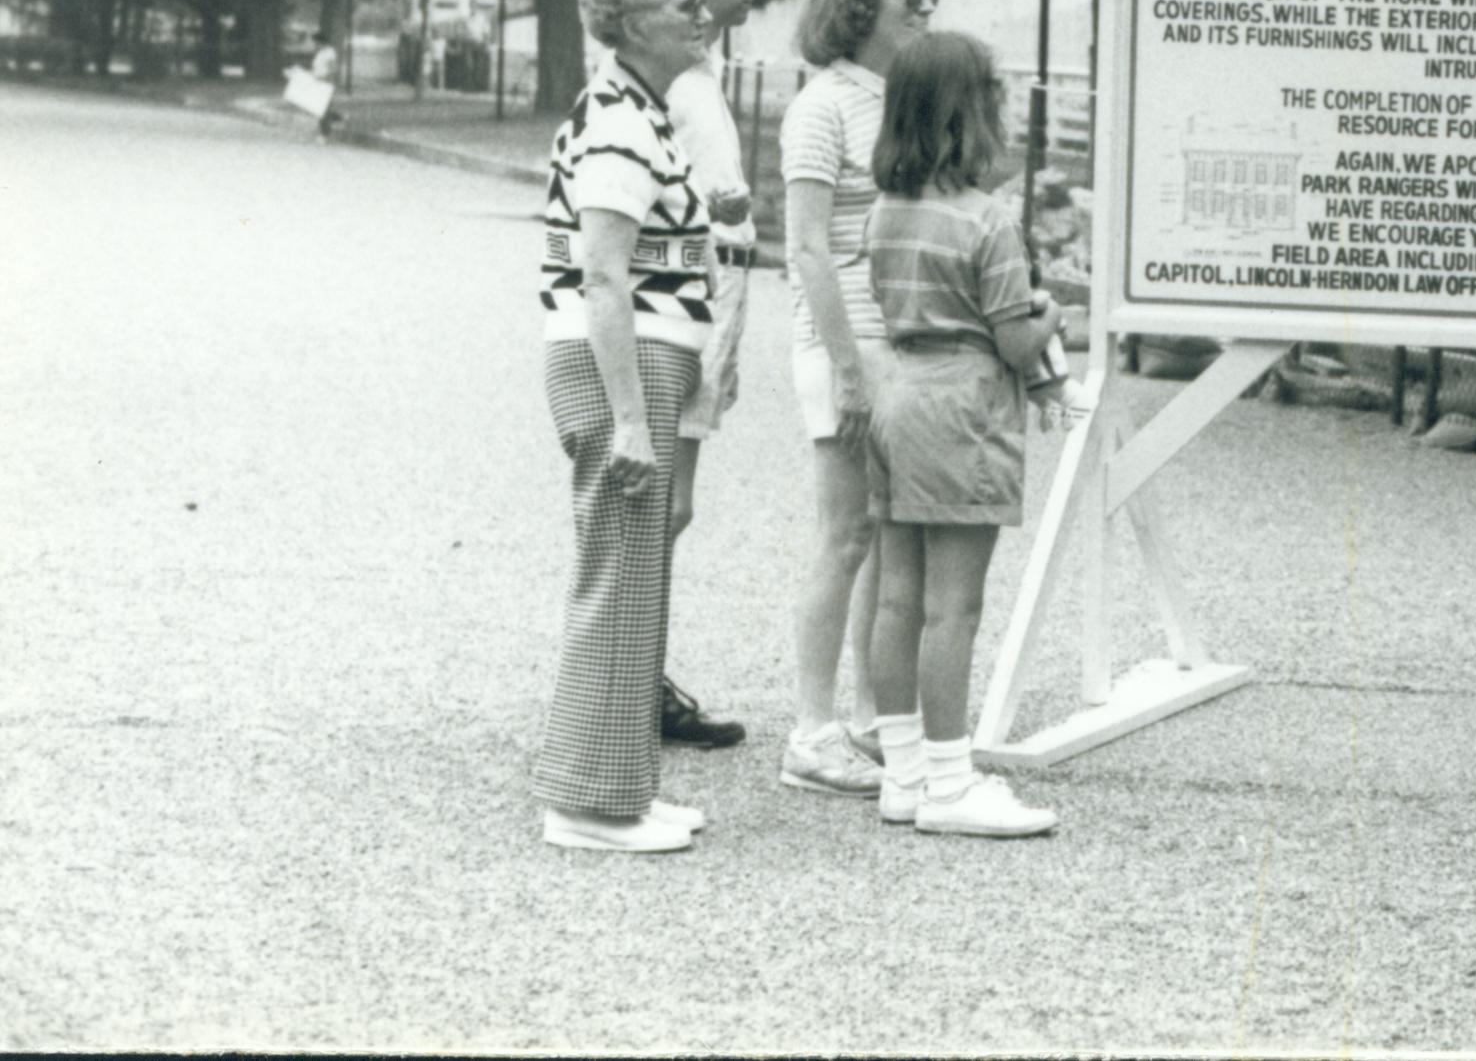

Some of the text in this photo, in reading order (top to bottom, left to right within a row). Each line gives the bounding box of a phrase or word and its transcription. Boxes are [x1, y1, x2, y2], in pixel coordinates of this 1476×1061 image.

[1273, 5, 1335, 24] WHILE
[1344, 7, 1379, 26] THE
[1163, 24, 1200, 41] AND
[1208, 25, 1238, 44] ITS
[1246, 27, 1371, 49] FURNISHINGS
[1381, 33, 1428, 52] WILL
[1281, 88, 1315, 108] THE
[1323, 90, 1441, 112] COMPLETION
[1446, 95, 1471, 114] OF
[1338, 115, 1437, 136] RESOURCE
[1403, 154, 1435, 173] WE
[1301, 175, 1351, 192] PARK
[1358, 177, 1448, 196] RANGERS
[1326, 199, 1372, 218] HAVE
[1307, 222, 1338, 241] WE
[1349, 224, 1464, 246] ENCOURAGE
[1272, 245, 1329, 264] FIELD
[1334, 248, 1389, 266] AREA
[1403, 275, 1442, 292] LAW
